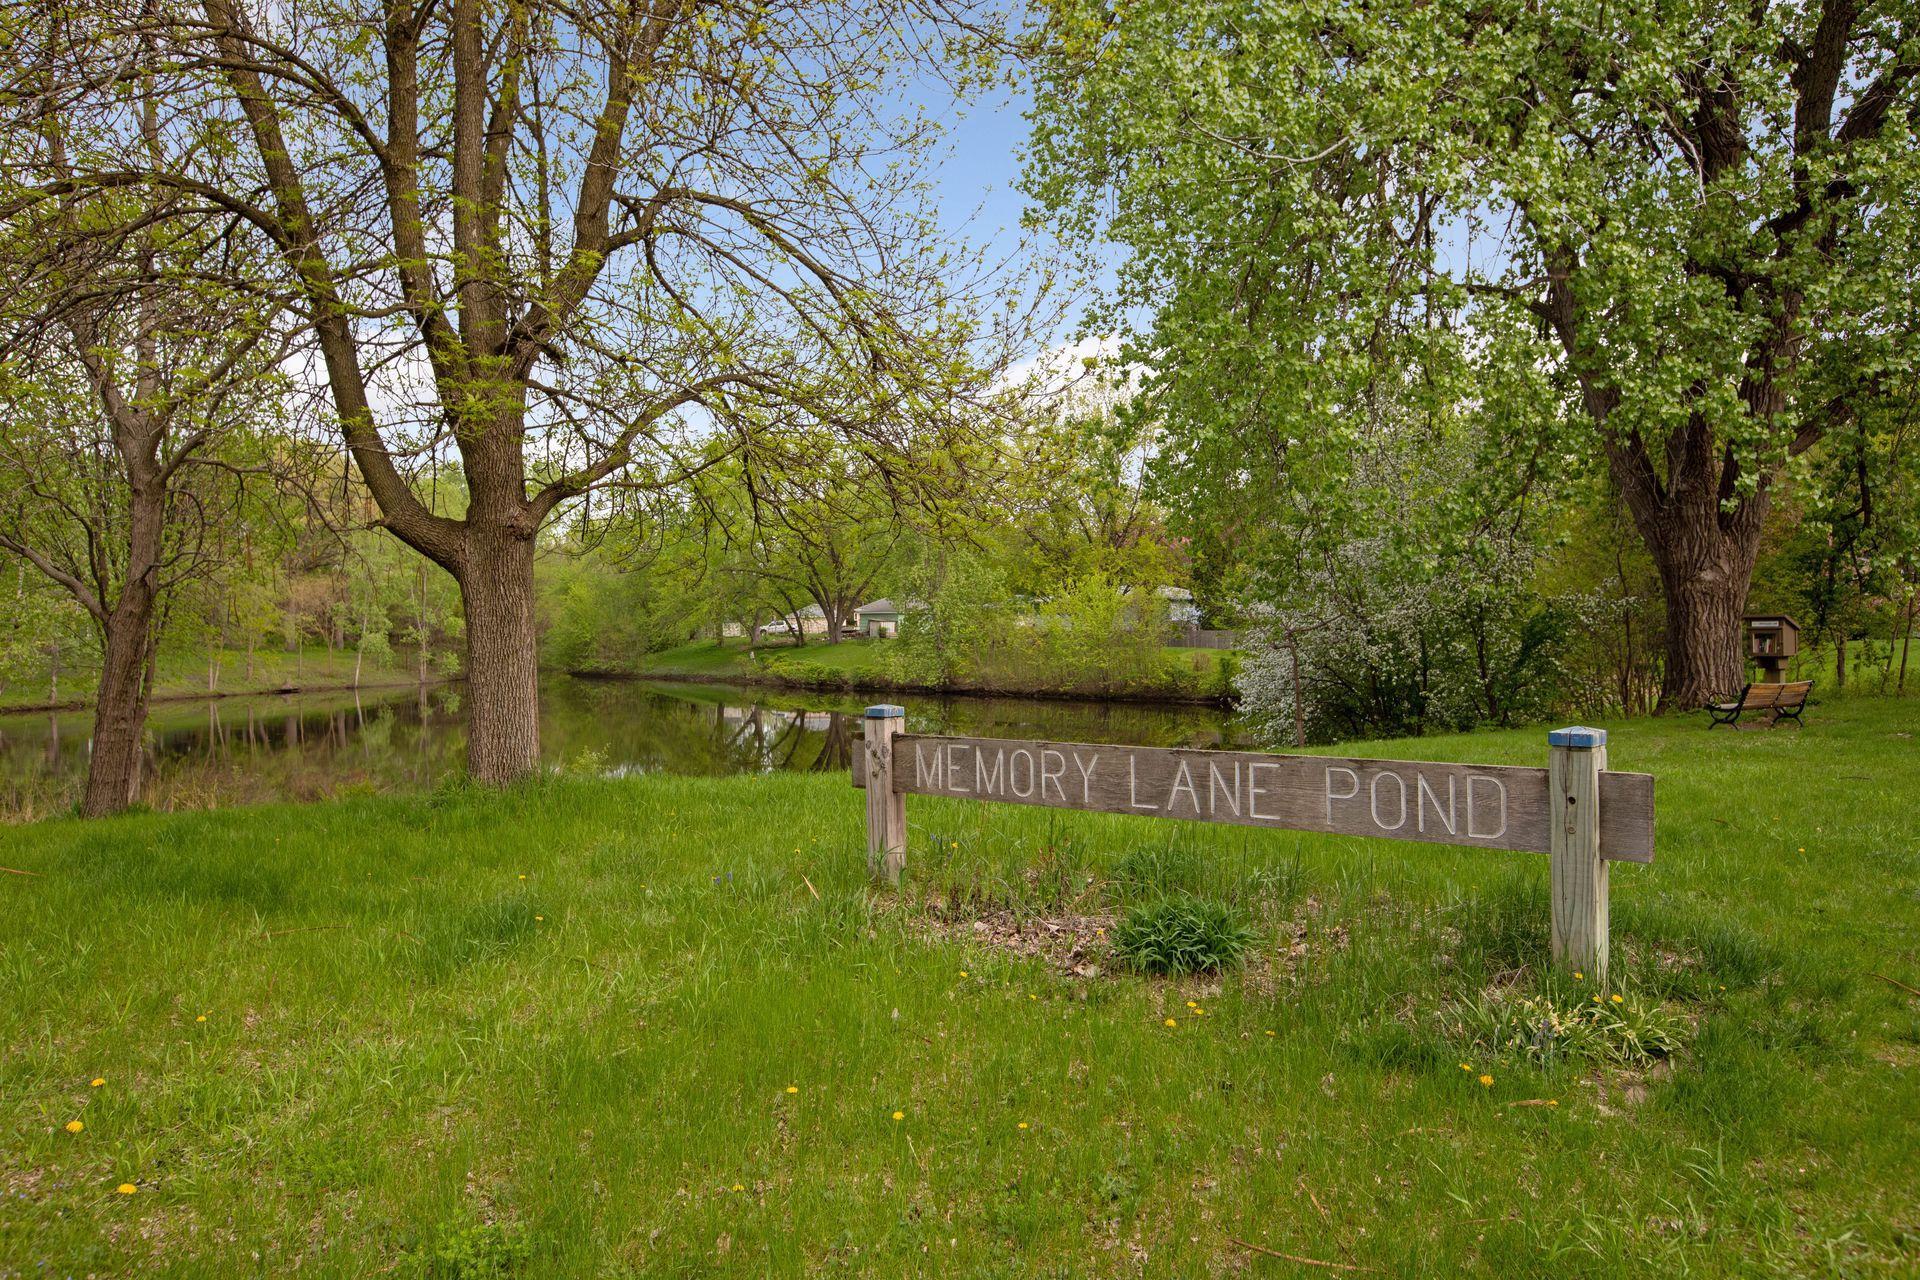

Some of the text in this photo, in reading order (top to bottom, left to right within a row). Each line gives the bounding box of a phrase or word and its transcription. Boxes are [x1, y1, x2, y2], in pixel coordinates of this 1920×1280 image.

[916, 743, 1508, 839] MEMORY LANE POND
